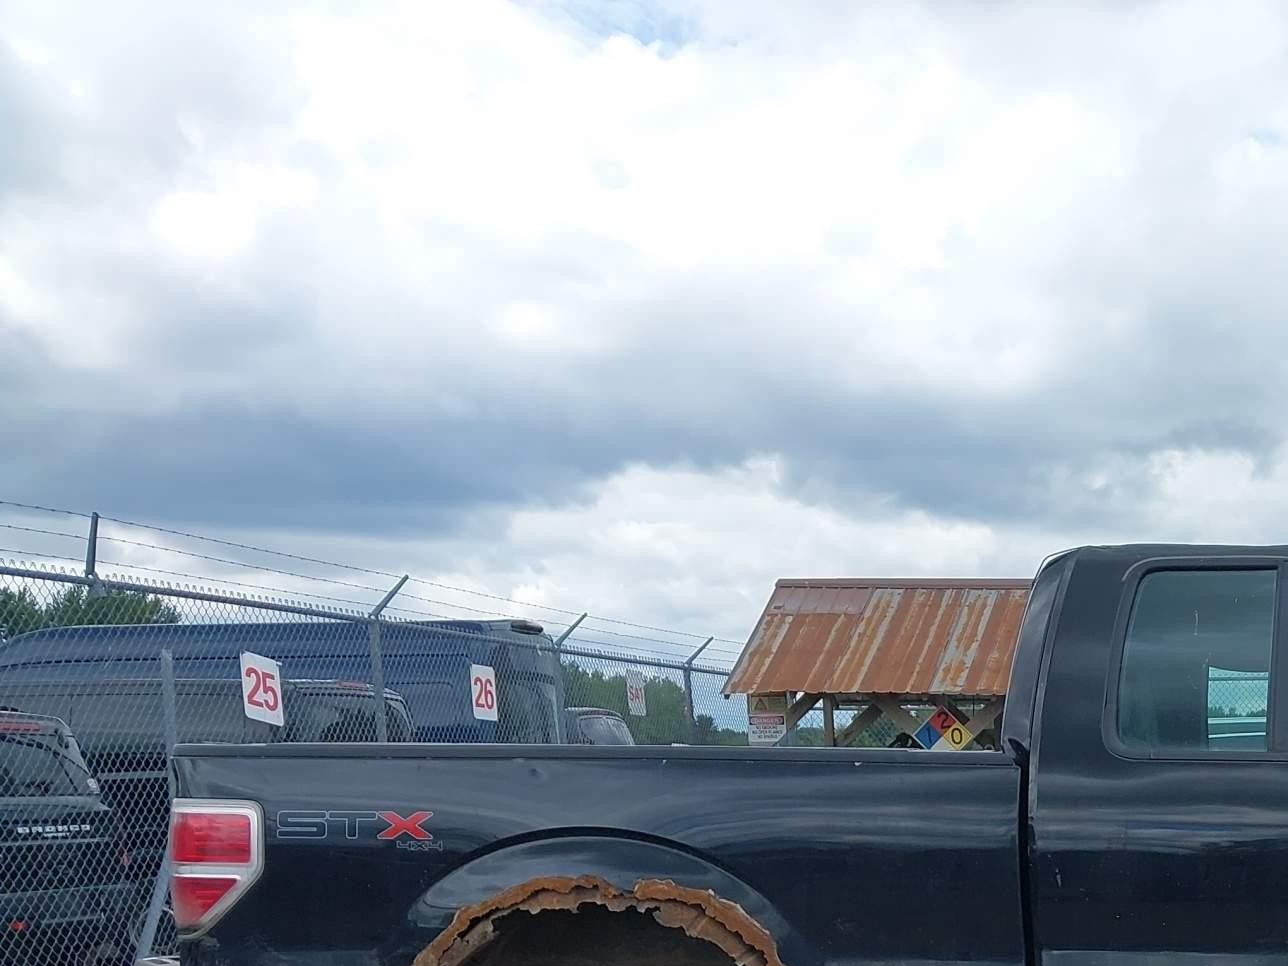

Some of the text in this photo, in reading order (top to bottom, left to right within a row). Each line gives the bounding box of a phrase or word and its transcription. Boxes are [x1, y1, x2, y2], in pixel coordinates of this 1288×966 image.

[245, 667, 279, 712] 25
[473, 676, 495, 710] 26
[937, 711, 951, 729] 2
[951, 727, 963, 745] 0
[277, 810, 434, 840] STX
